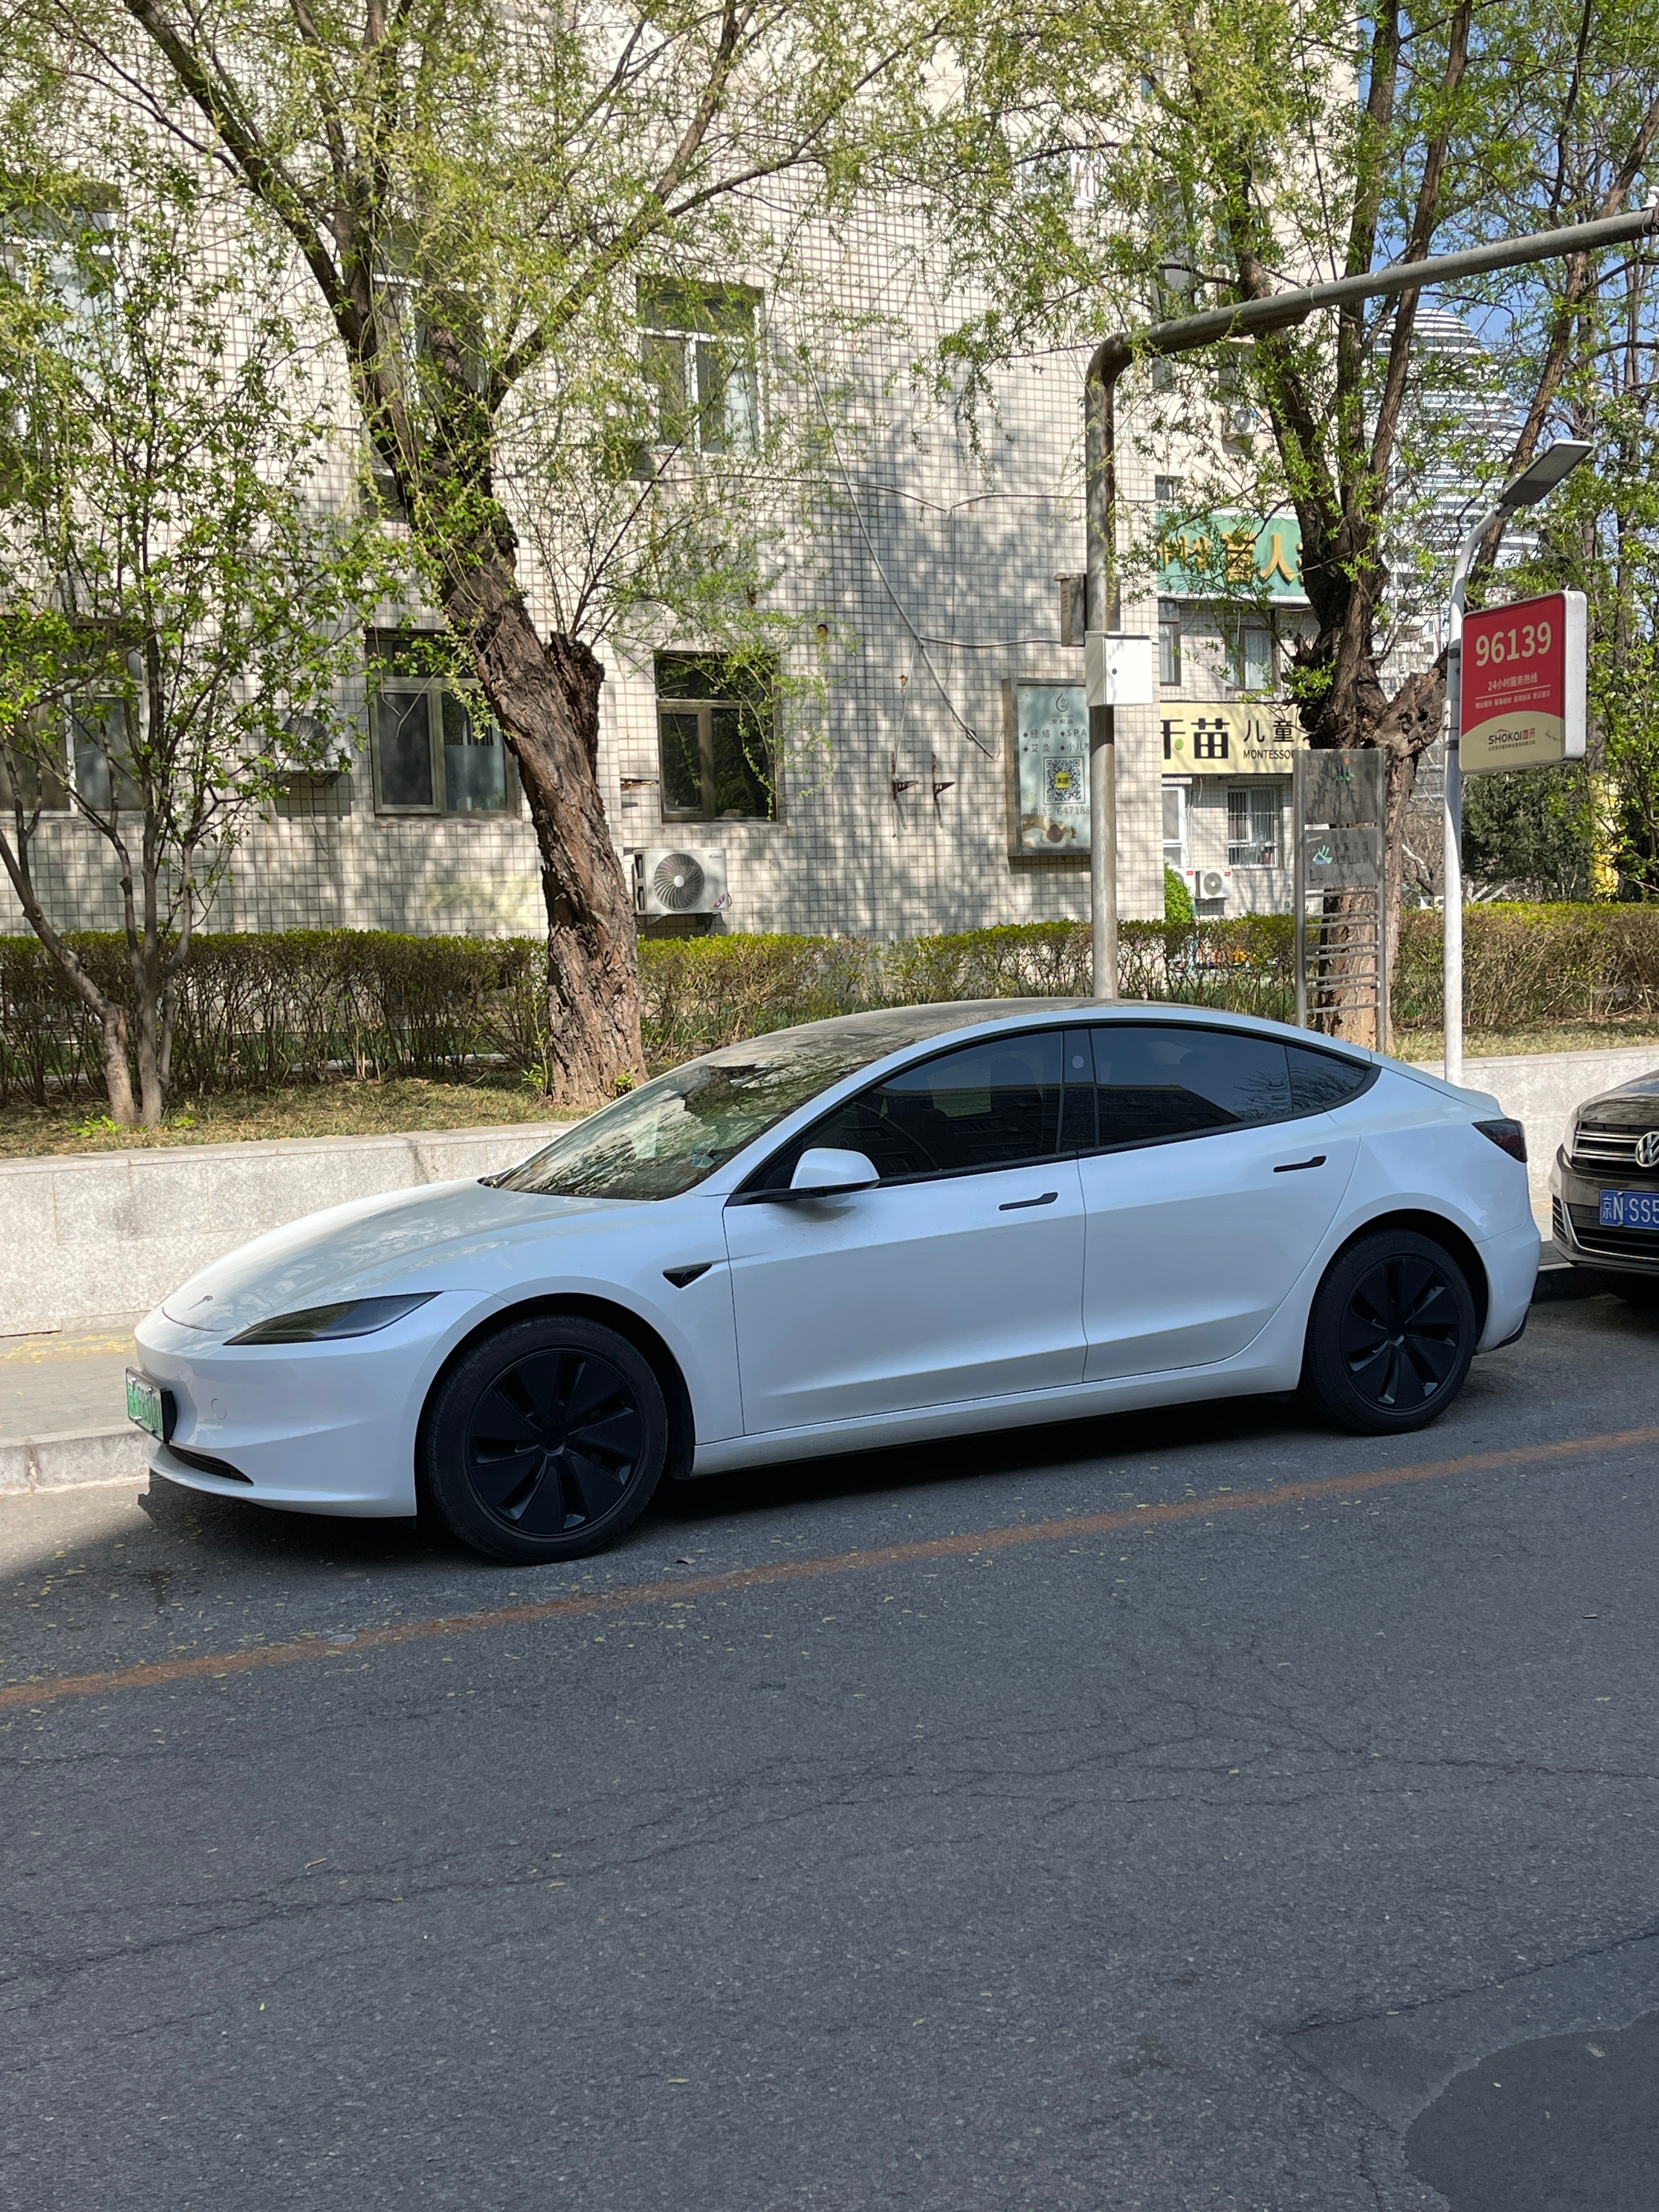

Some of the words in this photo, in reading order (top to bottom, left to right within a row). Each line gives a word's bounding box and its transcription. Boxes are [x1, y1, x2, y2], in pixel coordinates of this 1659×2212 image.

[1476, 622, 1551, 667] 96139
[1488, 672, 1538, 691] 24小时服务热线
